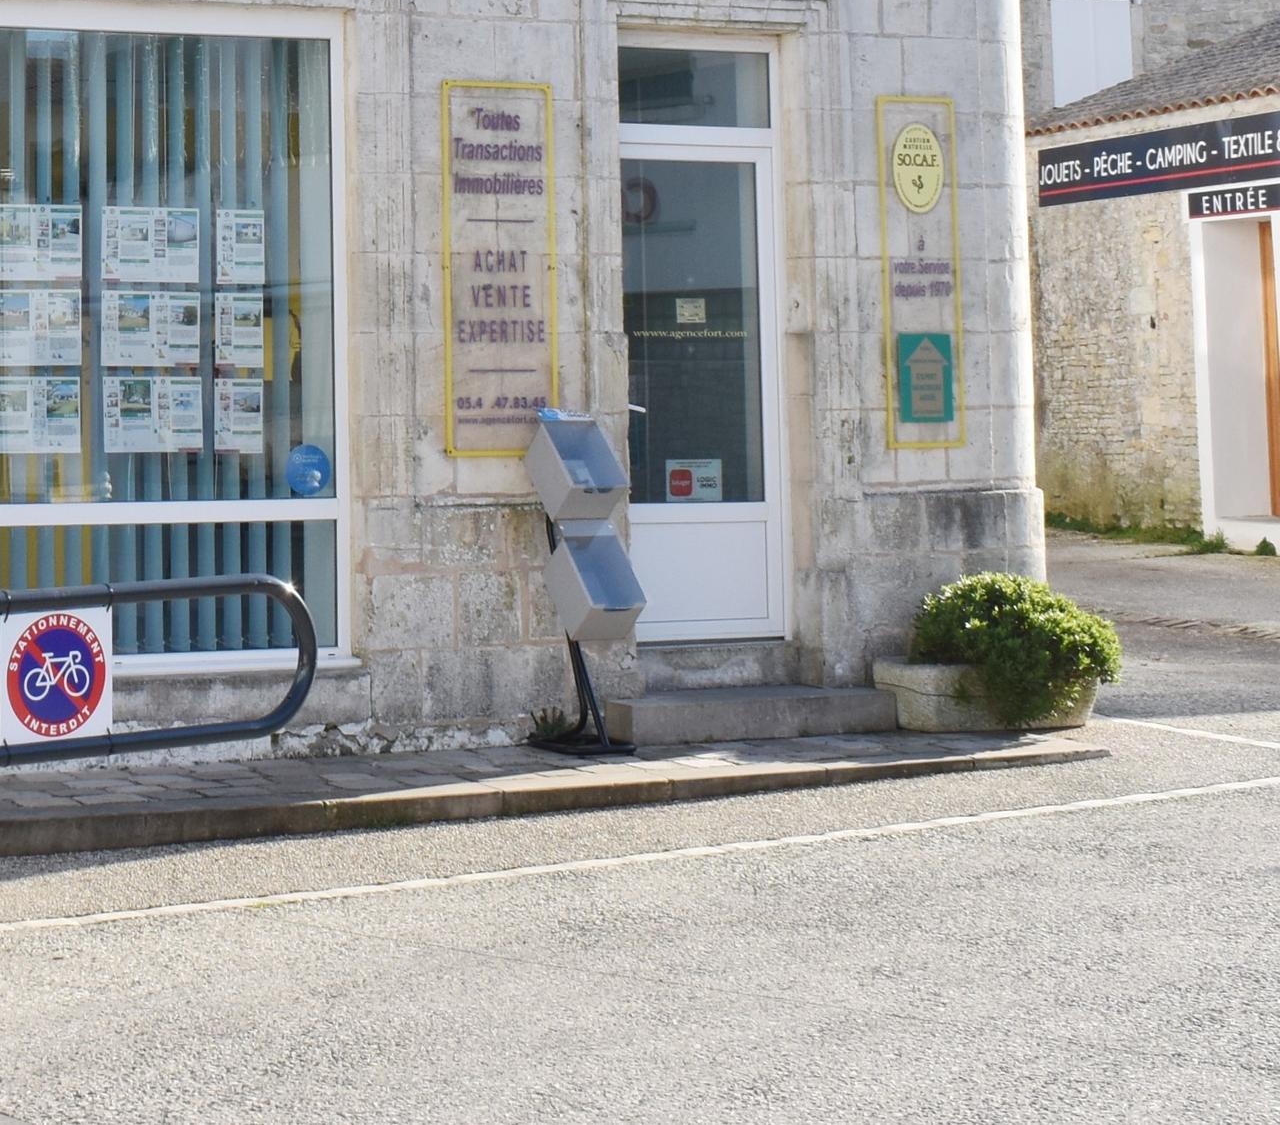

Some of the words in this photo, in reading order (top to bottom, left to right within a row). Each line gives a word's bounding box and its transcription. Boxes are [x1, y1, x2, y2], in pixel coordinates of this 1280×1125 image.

[475, 107, 521, 132] Toutes
[453, 137, 543, 162] Transactions
[1039, 159, 1082, 186] JOUETS
[1093, 151, 1133, 177] PÊCHE
[1145, 141, 1207, 170] CAMPING
[1222, 130, 1273, 159] TEXTILE
[1201, 186, 1268, 215] ENTRÉE
[473, 249, 528, 273] ACHAT
[471, 283, 531, 308] VENTE
[458, 319, 545, 343] EXPERTISE
[9, 615, 104, 672] STATIONNEMENT
[23, 705, 91, 735] INTERDIT
